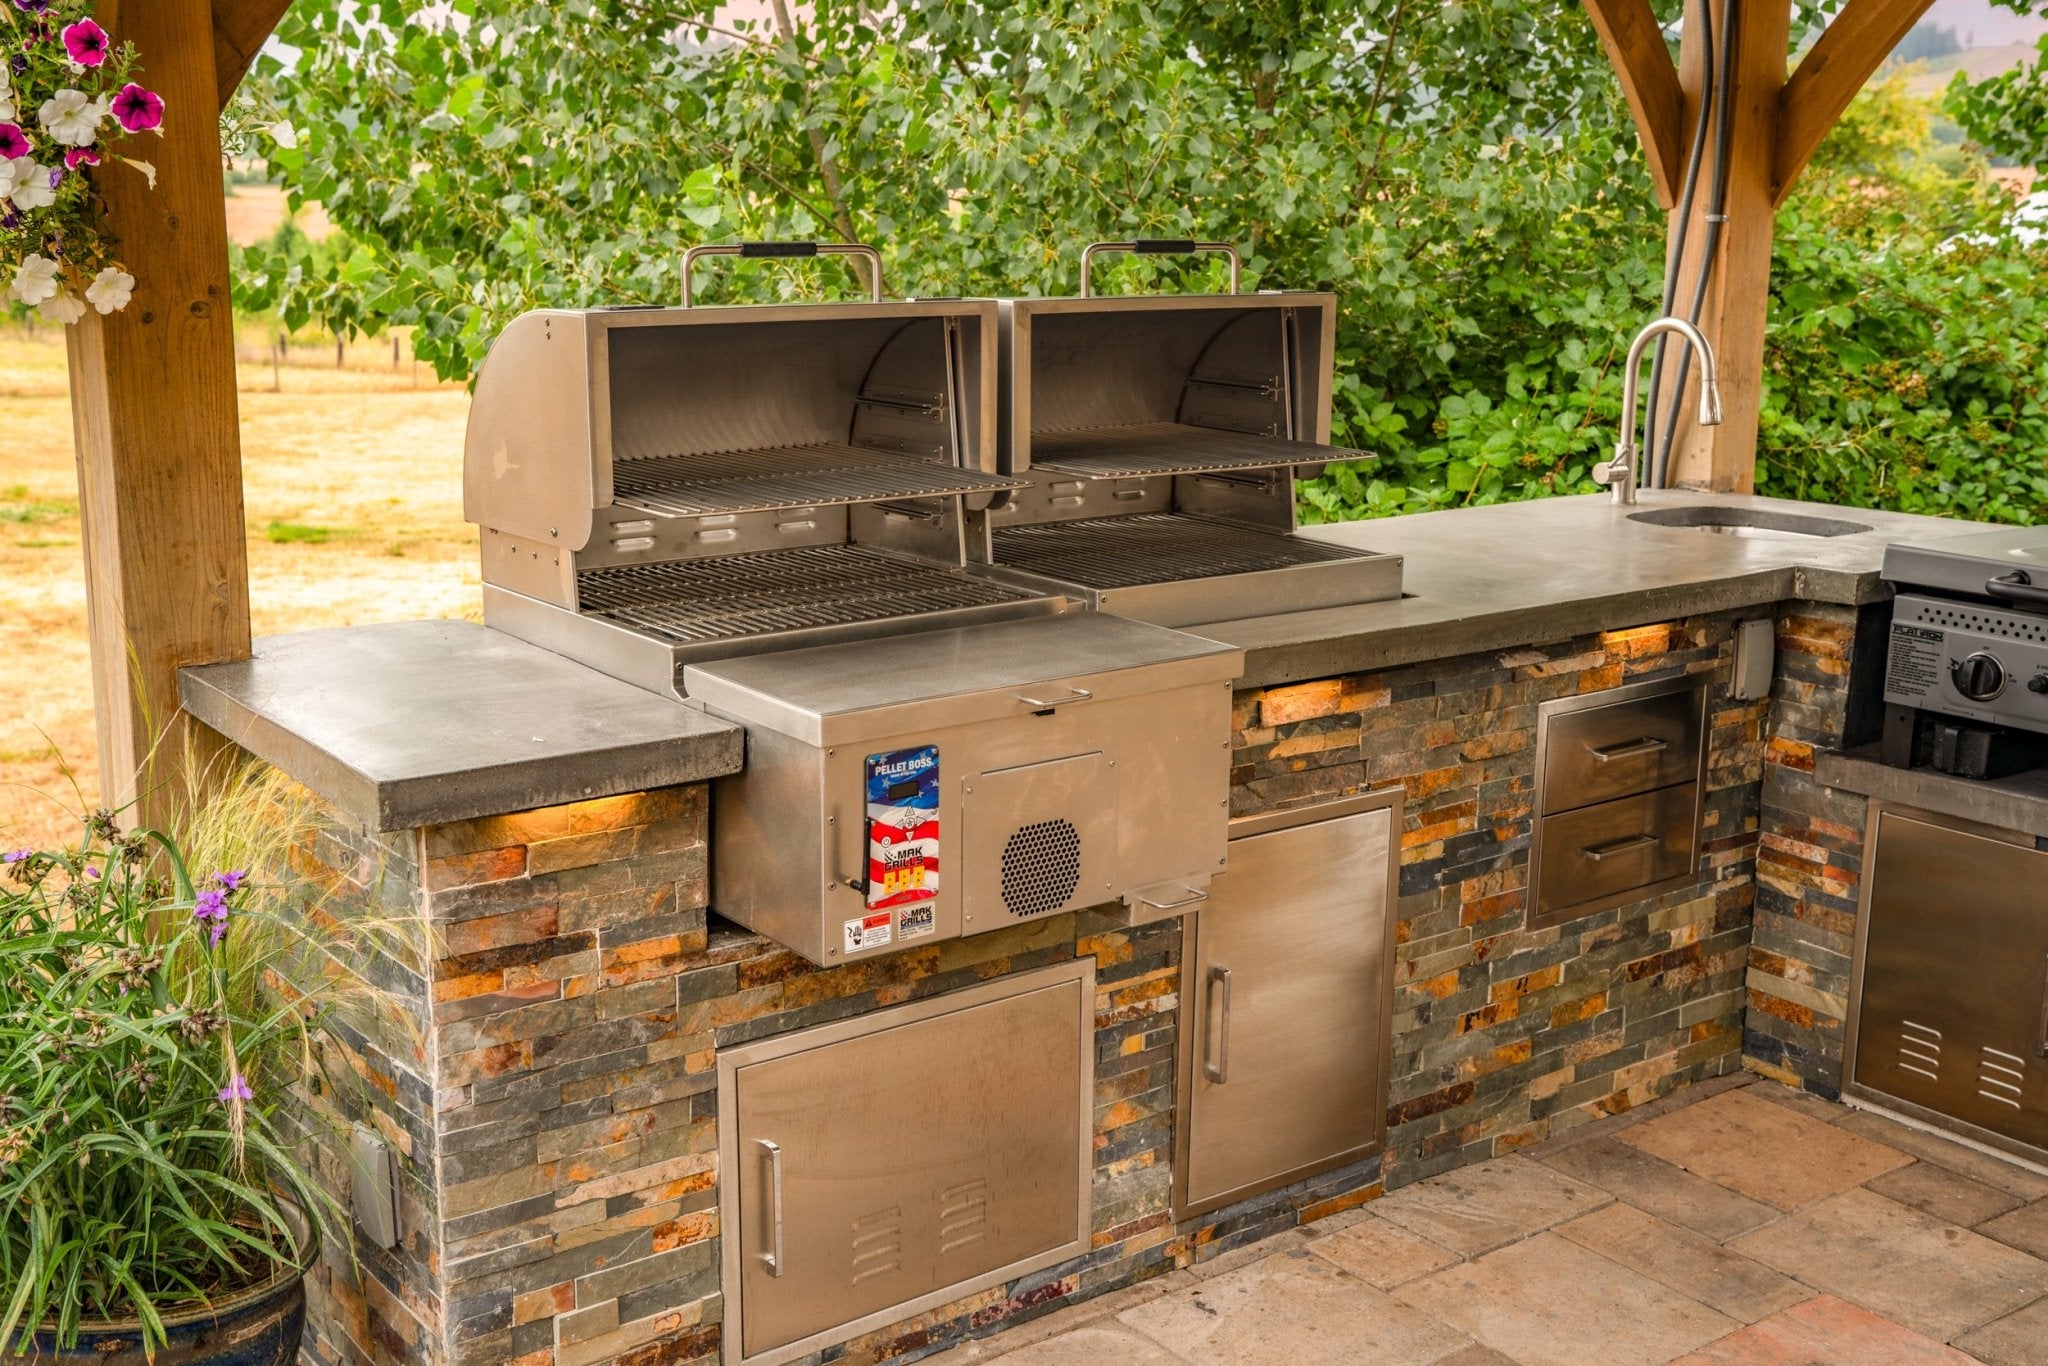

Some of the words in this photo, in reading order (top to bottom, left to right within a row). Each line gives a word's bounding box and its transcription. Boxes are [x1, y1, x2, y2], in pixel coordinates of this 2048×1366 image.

[1893, 625, 1918, 636] FLAT
[875, 761, 907, 776] PELLET
[908, 757, 932, 770] BOSS
[897, 846, 922, 860] MAK
[884, 855, 923, 871] GRILLS
[911, 905, 932, 917] MAK
[900, 913, 932, 927] GRILLS
